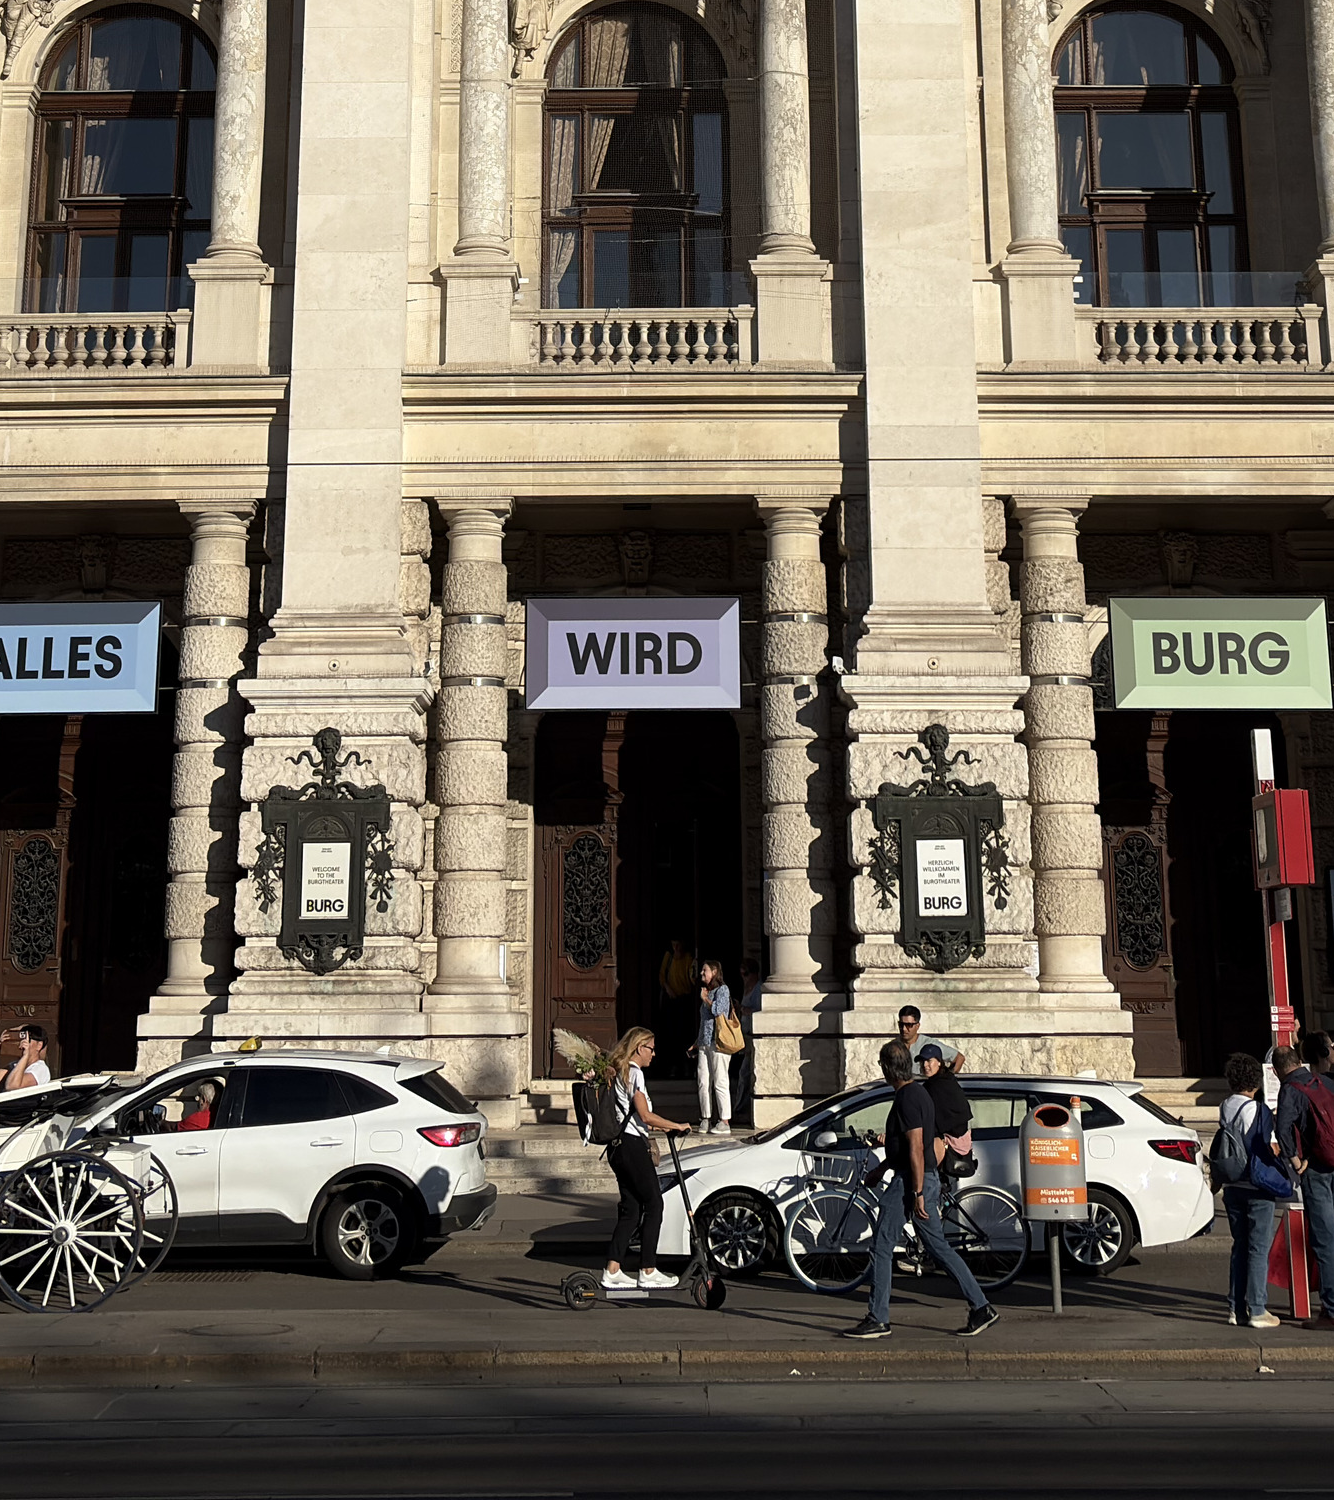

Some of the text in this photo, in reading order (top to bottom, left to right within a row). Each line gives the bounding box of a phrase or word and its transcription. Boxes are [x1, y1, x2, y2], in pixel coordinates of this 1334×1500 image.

[565, 631, 703, 676] WIRD
[1152, 631, 1291, 677] BURG
[306, 899, 344, 912] BURG
[924, 896, 962, 910] BURG
